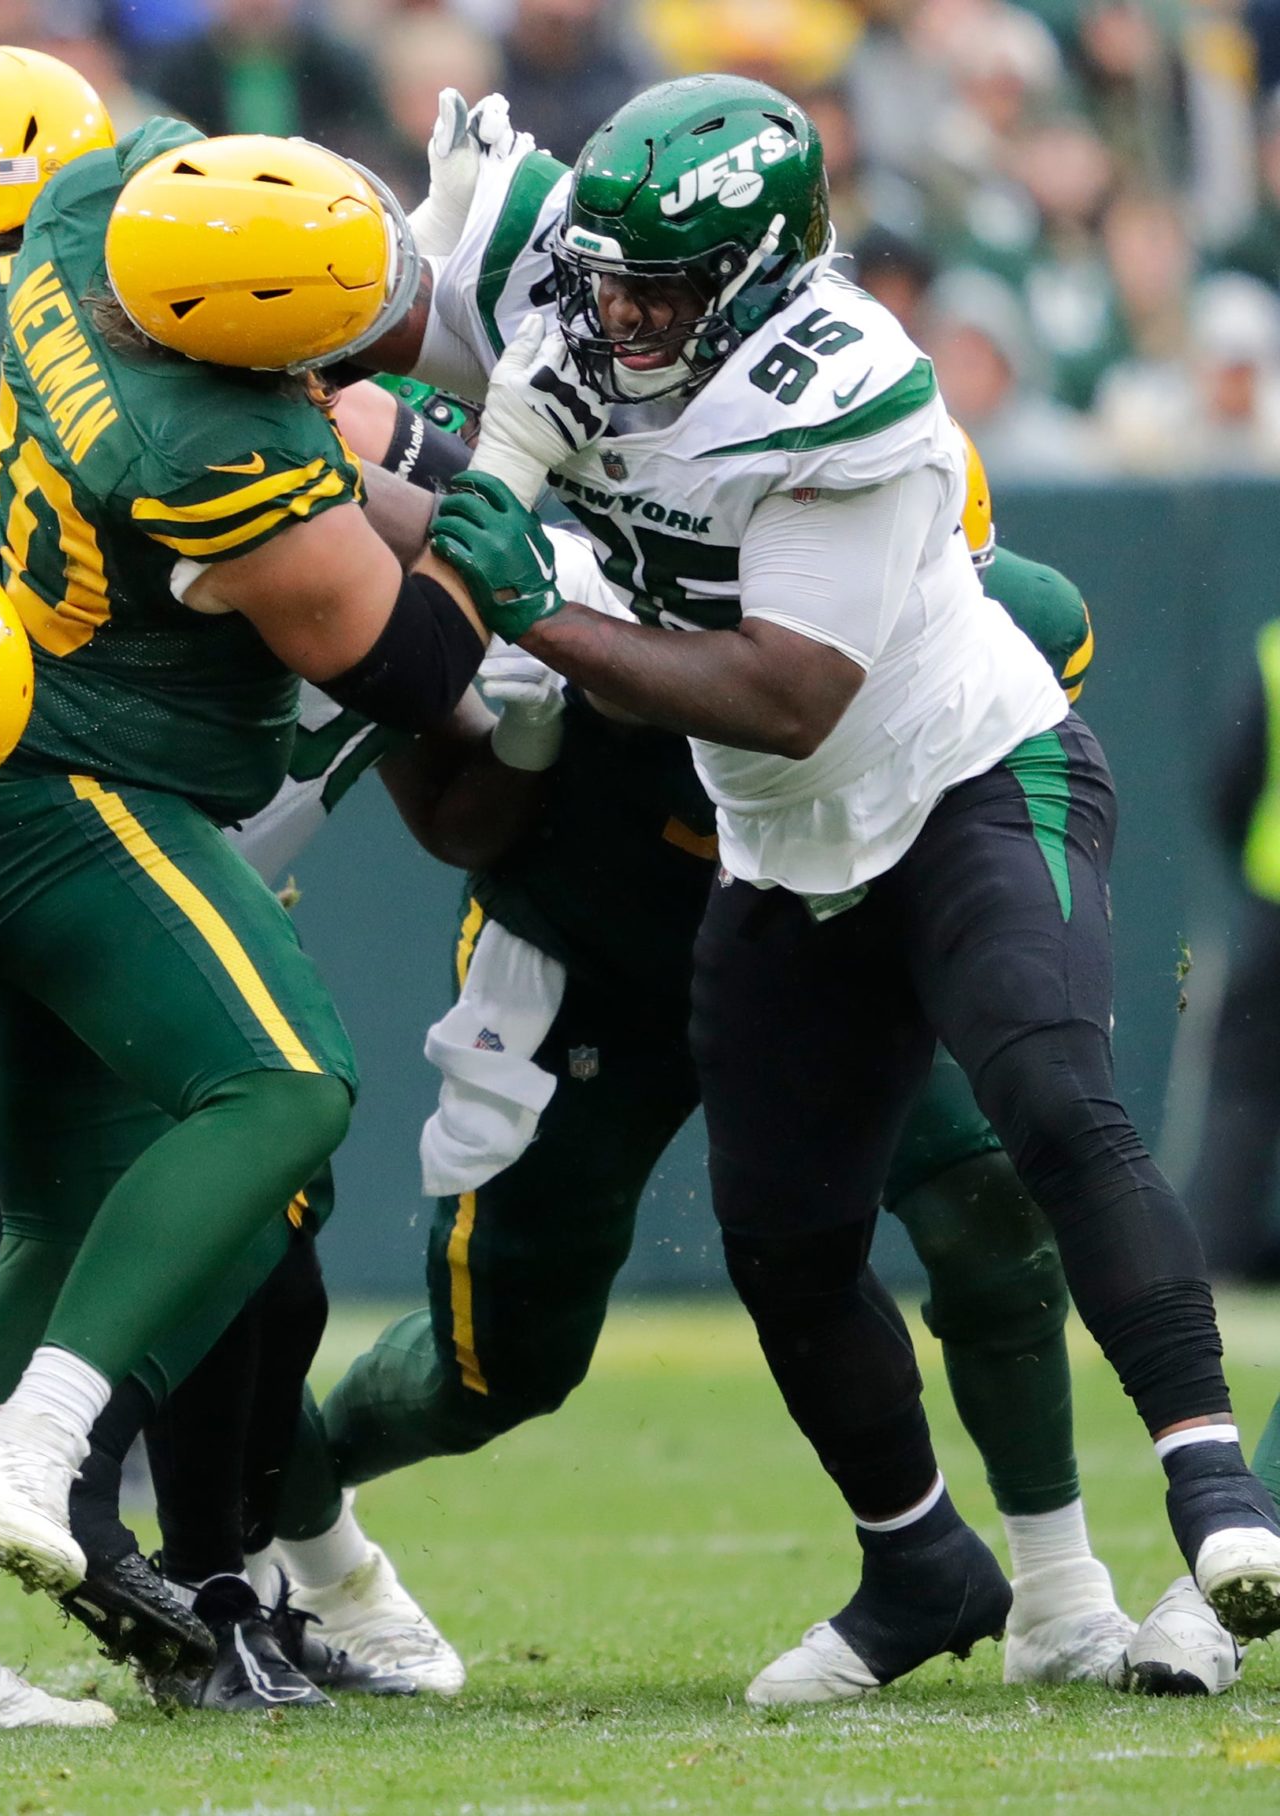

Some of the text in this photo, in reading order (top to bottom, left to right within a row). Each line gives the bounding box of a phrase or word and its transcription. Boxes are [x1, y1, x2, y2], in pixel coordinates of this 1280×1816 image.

[660, 126, 787, 216] JETS
[7, 261, 119, 465] NEWMAN
[748, 307, 864, 405] 95
[618, 495, 713, 533] YORK
